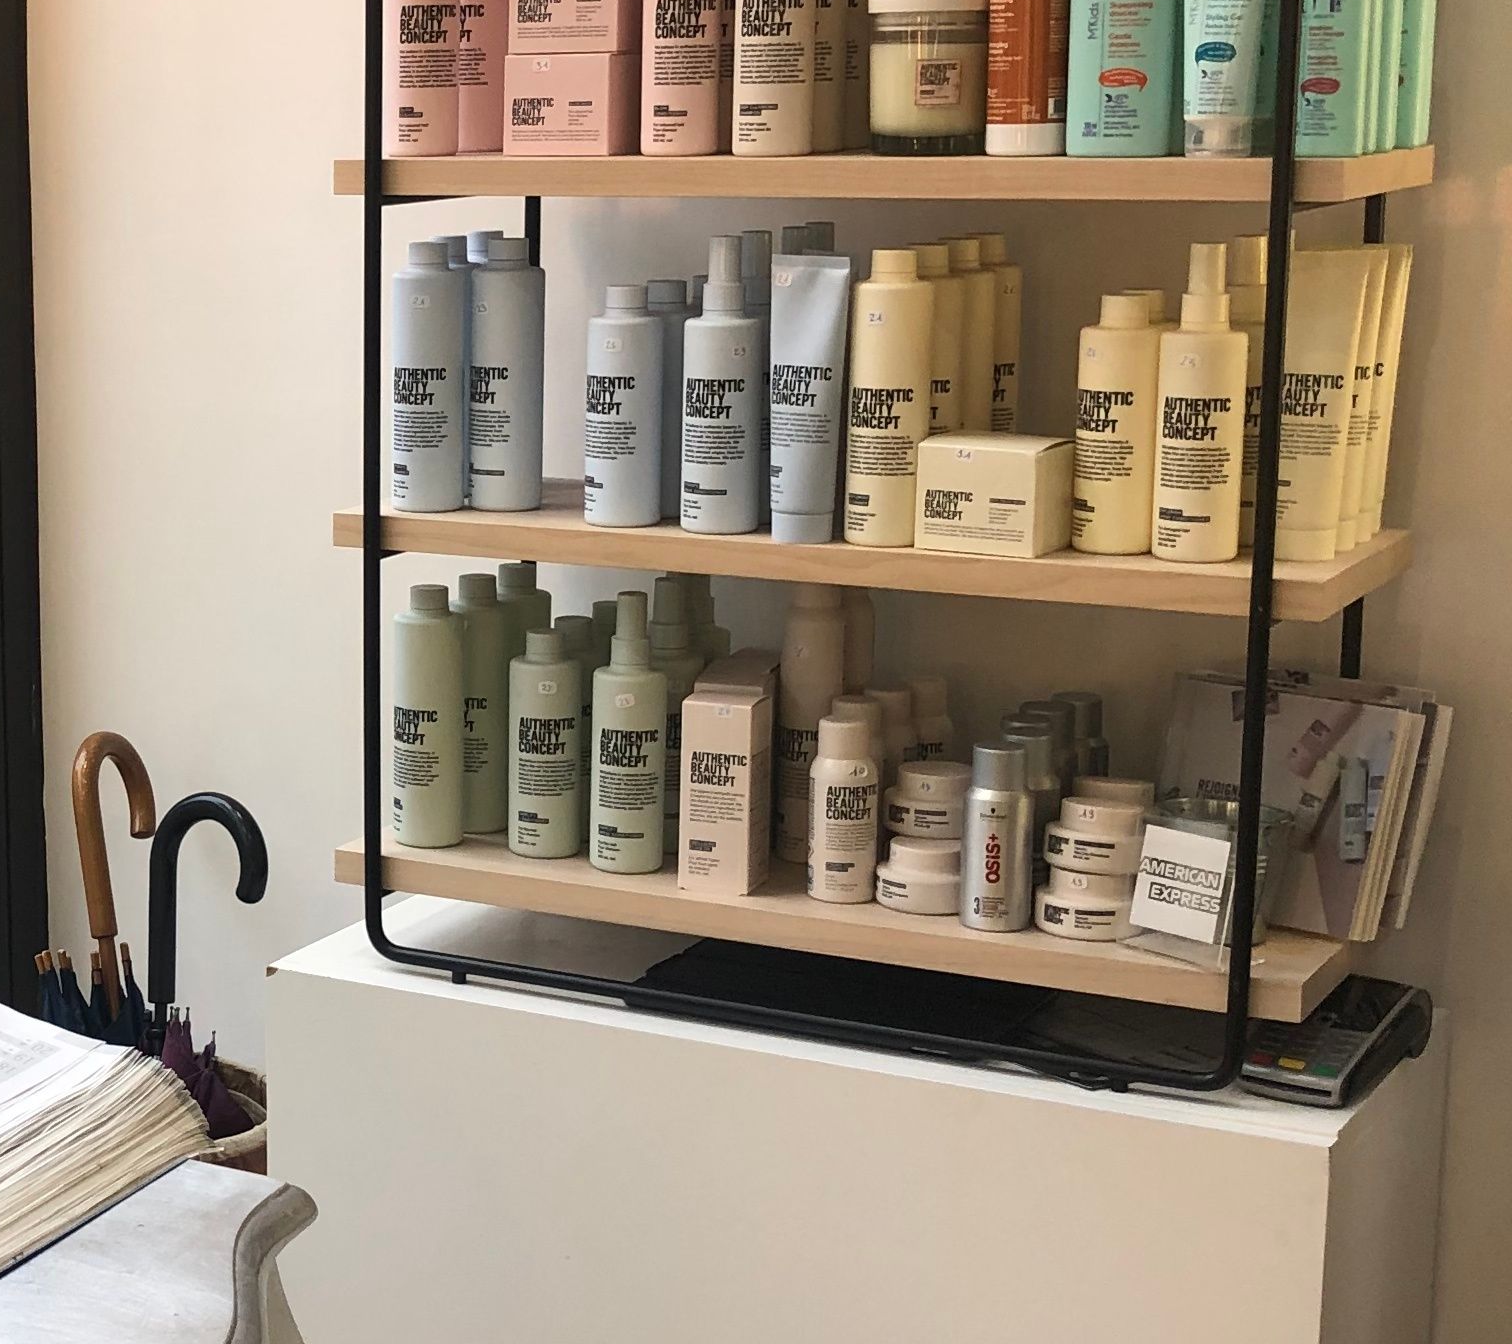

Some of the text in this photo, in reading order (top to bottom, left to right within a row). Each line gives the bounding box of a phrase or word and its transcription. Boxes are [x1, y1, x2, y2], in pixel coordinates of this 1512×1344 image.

[400, 4, 456, 20] AUTHENTIC
[518, 4, 549, 14] BEAUTY
[742, 9, 786, 24] BEAUTY
[400, 18, 443, 32] BEAUTY
[517, 13, 552, 24] CONCEPT
[656, 11, 701, 26] BEAUTY
[400, 30, 448, 44] CONCEPT
[655, 24, 707, 39] CONCEPT
[741, 22, 792, 38] CONCEPT
[512, 98, 554, 108] AUTHENTIC
[512, 107, 542, 118] BEAUTY
[511, 116, 546, 126] CONCEPT
[394, 367, 446, 380] AUTHENTIC
[772, 364, 832, 382] AUTHENTIC
[394, 380, 428, 393] BEAUTY
[686, 378, 745, 393] AUTHENTIC
[772, 378, 810, 394] BEAUTY
[393, 392, 434, 406] CONCEPT
[771, 392, 816, 408] CONCEPT
[852, 387, 914, 402] AUTHENTIC
[685, 404, 732, 420] CONCEPT
[851, 401, 892, 416] BEAUTY
[1164, 396, 1231, 414] AUTHENTIC
[850, 415, 900, 430] CONCEPT
[1163, 410, 1210, 428] BEAUTY
[1162, 426, 1218, 442] CONCEPT
[925, 488, 973, 503] AUTHENTIC
[924, 499, 958, 511] BEAUTY
[924, 509, 963, 522] CONCEPT
[520, 717, 576, 732] AUTHENTIC
[519, 730, 561, 744] BEAUTY
[600, 728, 658, 744] AUTHENTIC
[518, 742, 566, 755] CONCEPT
[600, 741, 642, 756] BEAUTY
[600, 754, 648, 768] CONCEPT
[691, 751, 748, 766] AUTHENTIC
[690, 762, 730, 776] BEAUTY
[690, 772, 736, 787] CONCEPT
[826, 796, 868, 810] BEAUTY
[826, 807, 872, 821] CONCEPT
[1140, 856, 1222, 890] AMERICAN
[1148, 882, 1222, 914] EXPRESS
